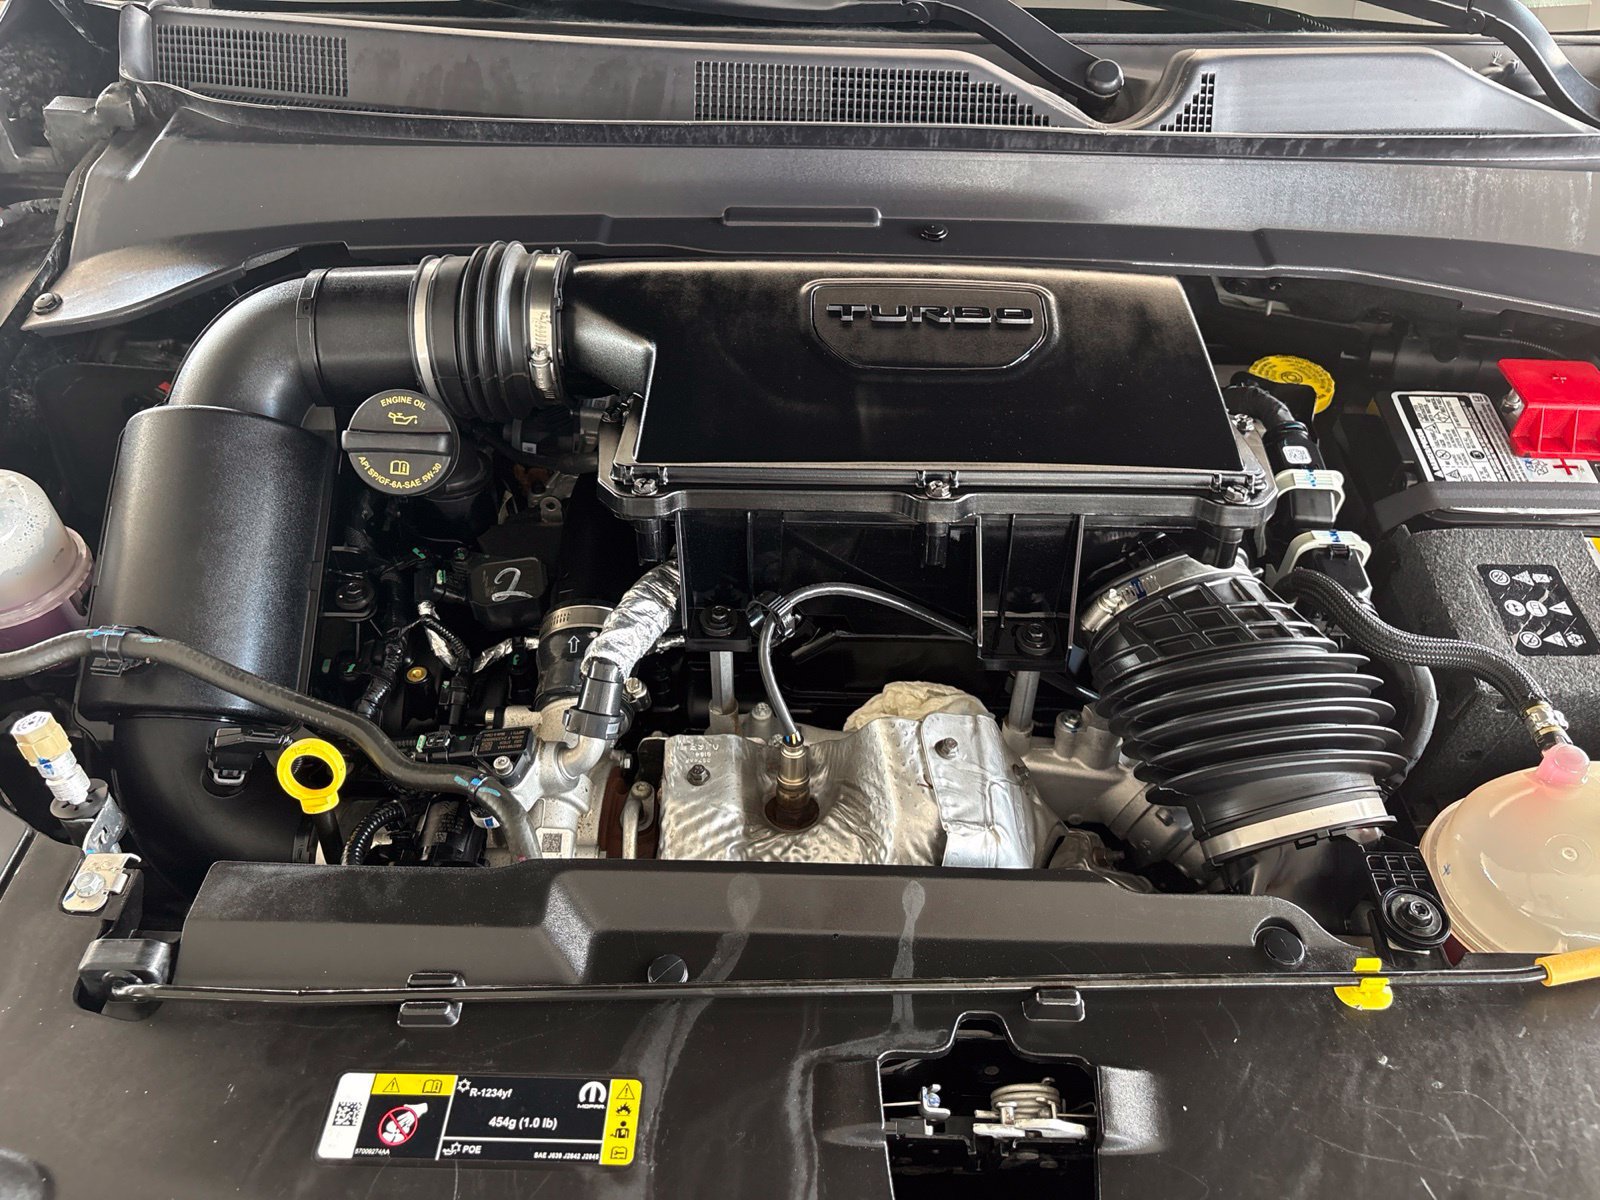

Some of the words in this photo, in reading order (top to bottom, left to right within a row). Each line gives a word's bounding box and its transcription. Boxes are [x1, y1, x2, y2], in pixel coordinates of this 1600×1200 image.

[826, 303, 1034, 325] TURBO
[380, 395, 413, 407] ENGINE
[413, 398, 427, 411] OIL
[358, 455, 371, 470] API
[422, 462, 442, 483] 5W-30
[491, 567, 534, 602] 2
[470, 1087, 513, 1099] R-1234yf
[488, 1116, 517, 1130] 454g
[518, 1117, 541, 1130] (1.0
[542, 1117, 558, 1131] lb)
[462, 1145, 482, 1155] POE
[533, 1151, 547, 1159] SAE
